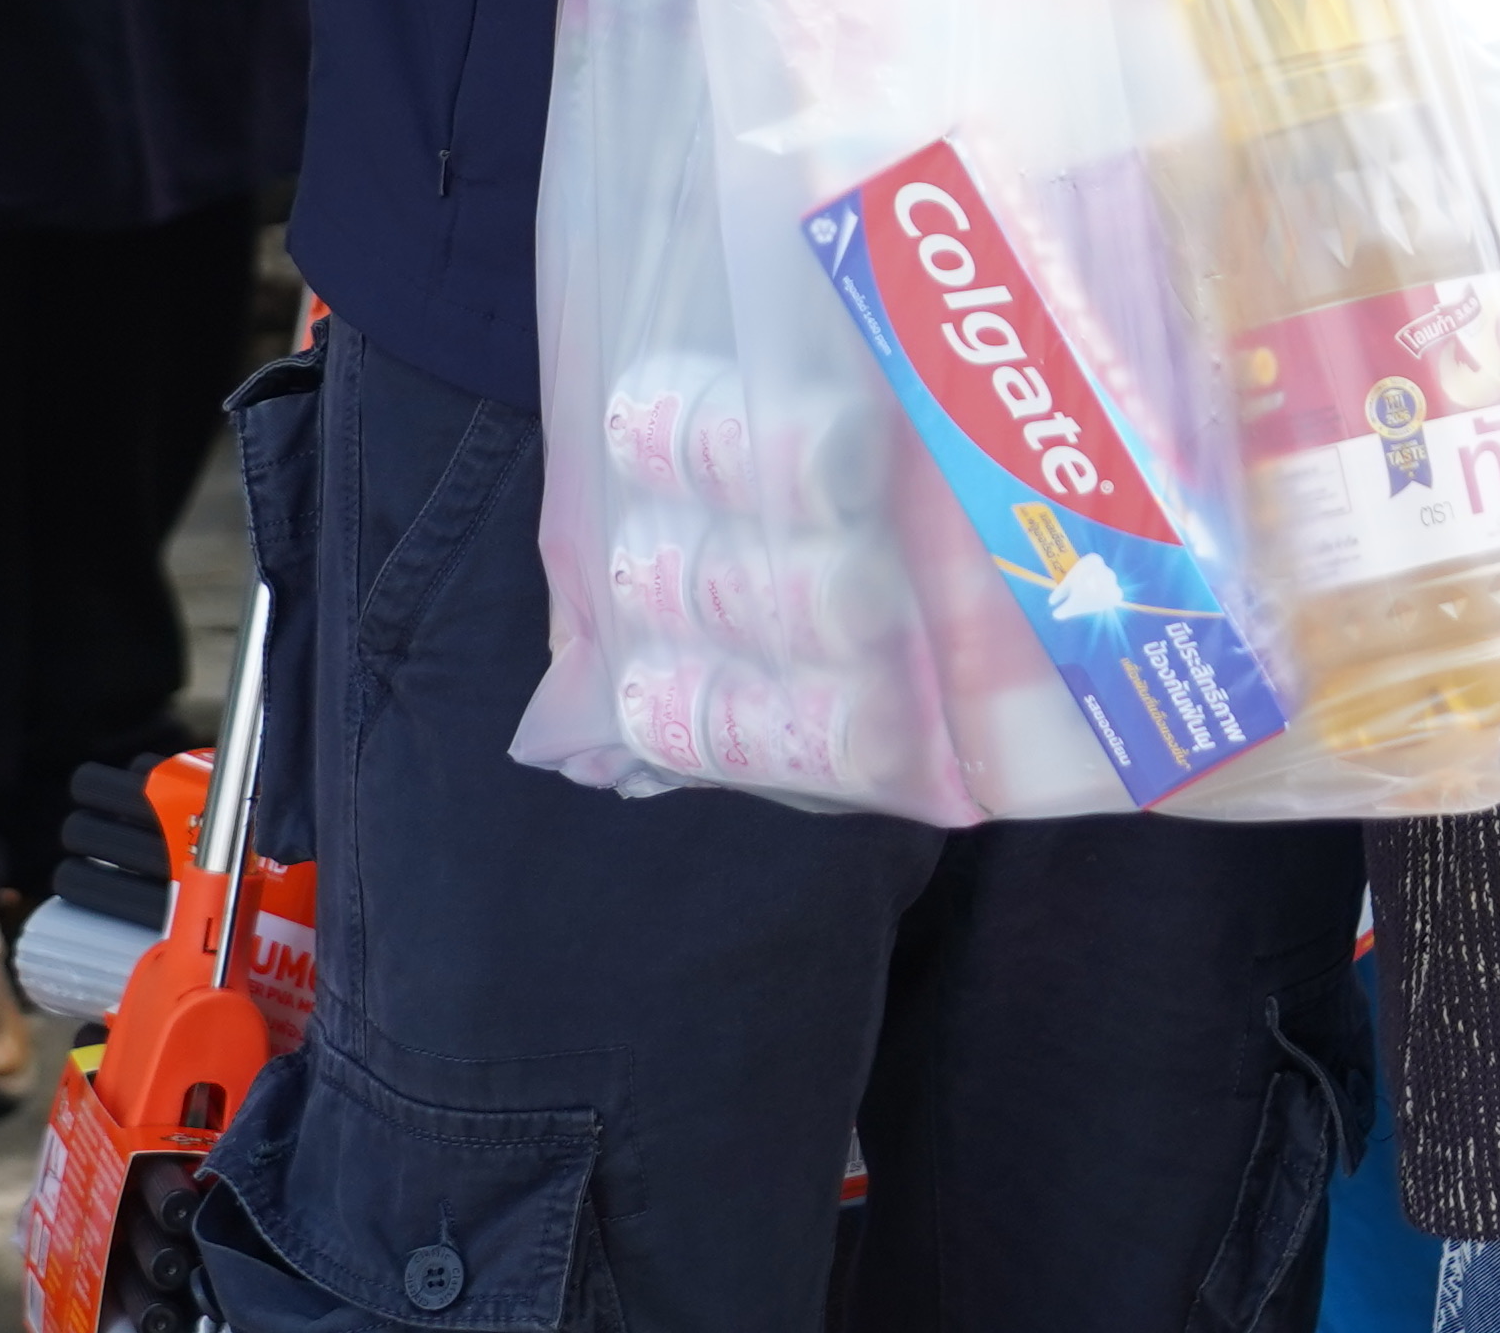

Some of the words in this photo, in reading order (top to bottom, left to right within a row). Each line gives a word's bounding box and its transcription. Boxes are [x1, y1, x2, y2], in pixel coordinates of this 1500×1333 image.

[863, 310, 882, 335] 1450
[893, 180, 1100, 497] Colgate
[1404, 313, 1457, 351] โอเมก้า
[1419, 499, 1457, 527] ตรา
[1142, 640, 1217, 754] ป้องกันฟันผุ
[1164, 621, 1247, 744] มีประสิทธิภาพ
[1083, 693, 1132, 767] รสยอดนิยม
